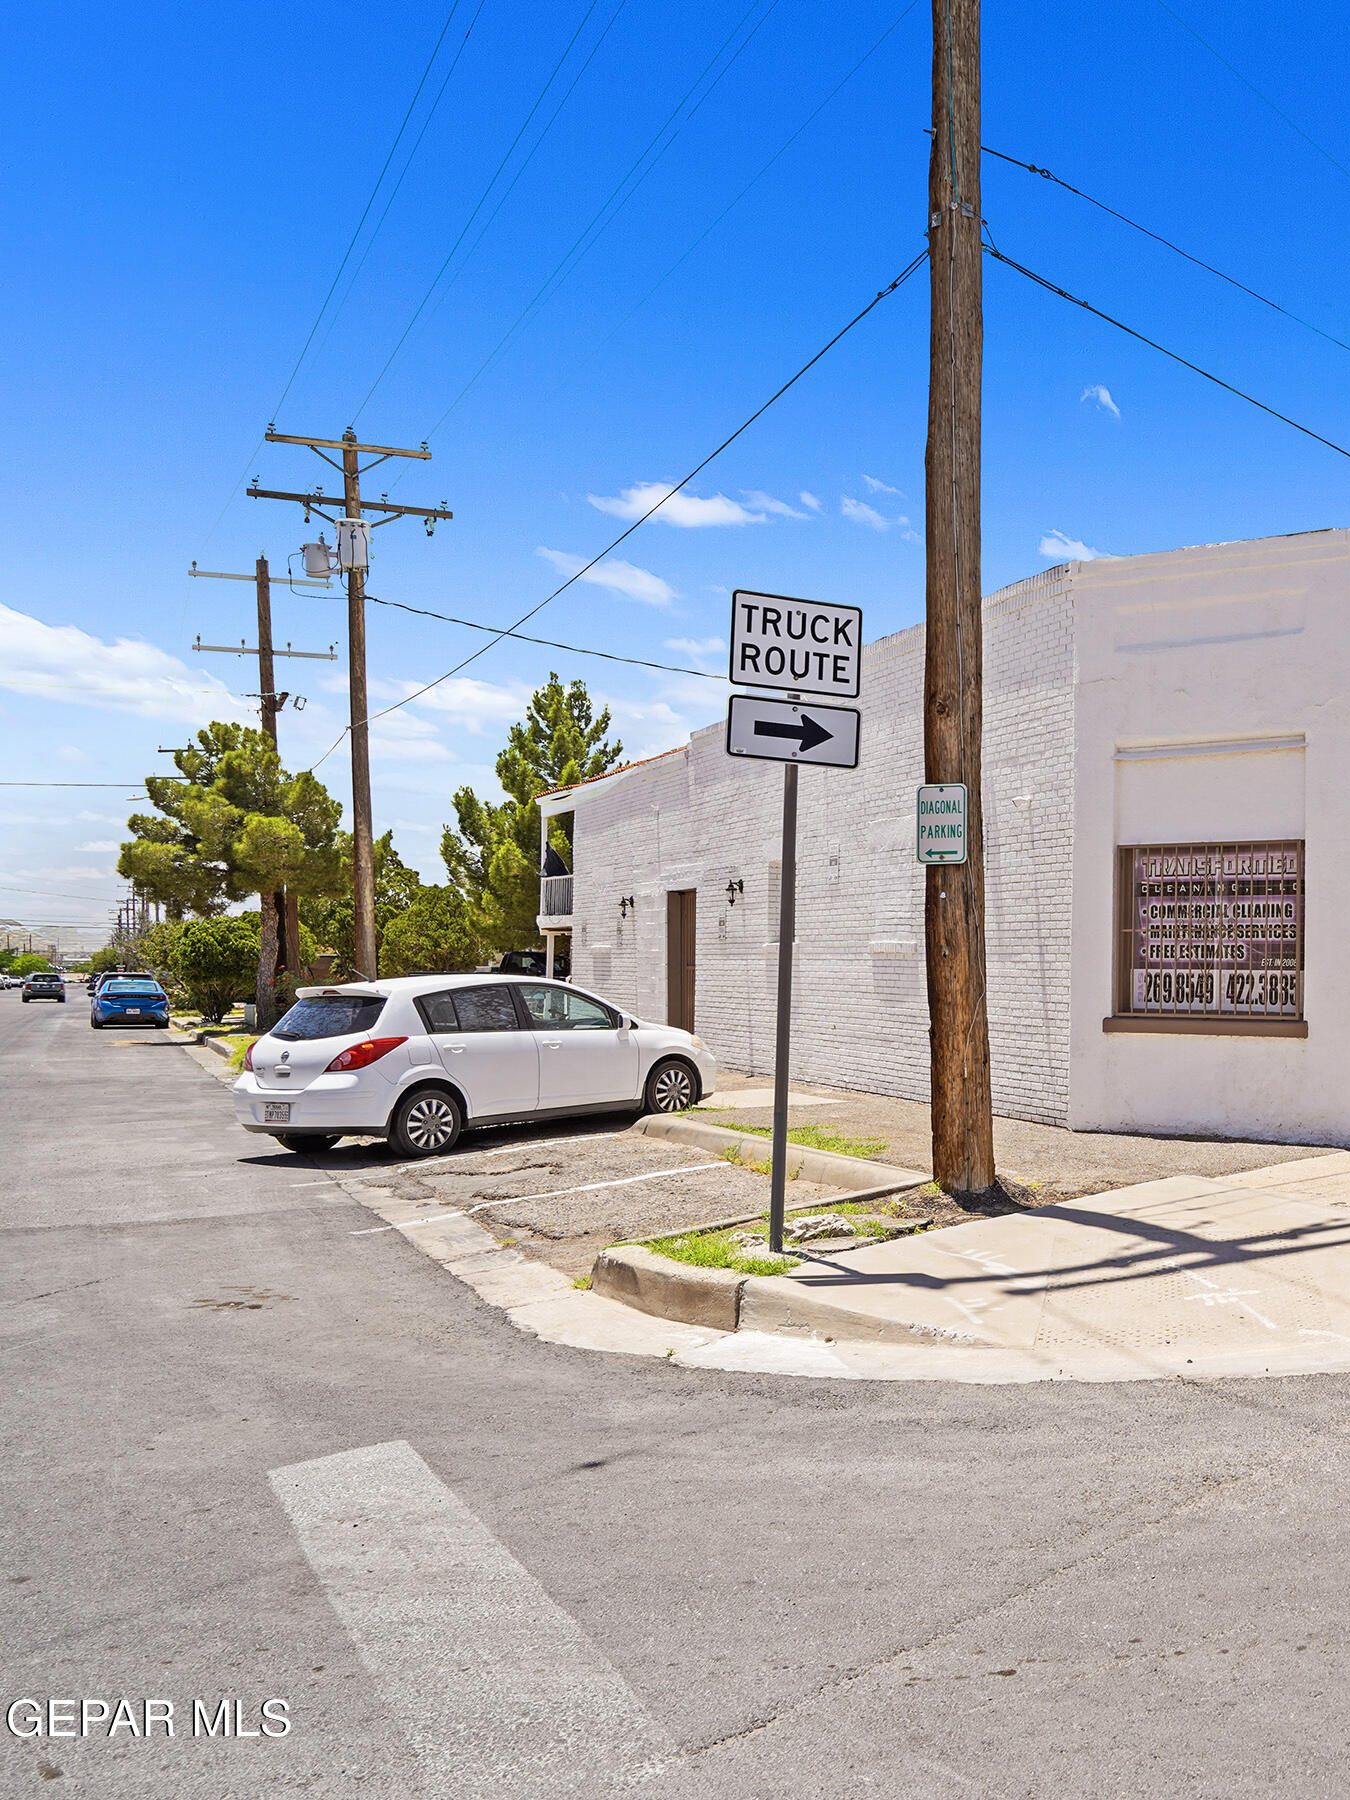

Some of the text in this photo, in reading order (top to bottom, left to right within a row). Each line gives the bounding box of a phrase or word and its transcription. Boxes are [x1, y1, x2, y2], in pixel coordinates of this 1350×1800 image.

[741, 603, 853, 647] TRUCK
[740, 643, 851, 684] ROUTE
[920, 799, 962, 814] DIAGONAL
[920, 824, 962, 839] PARKING
[1142, 855, 1297, 877] TRANSFORMED
[1150, 903, 1293, 919] COMMERCIAL CLEANING
[1150, 923, 1297, 939] MAINTENANCE SERVICES
[1150, 944, 1245, 959] FREE ESTIMATES
